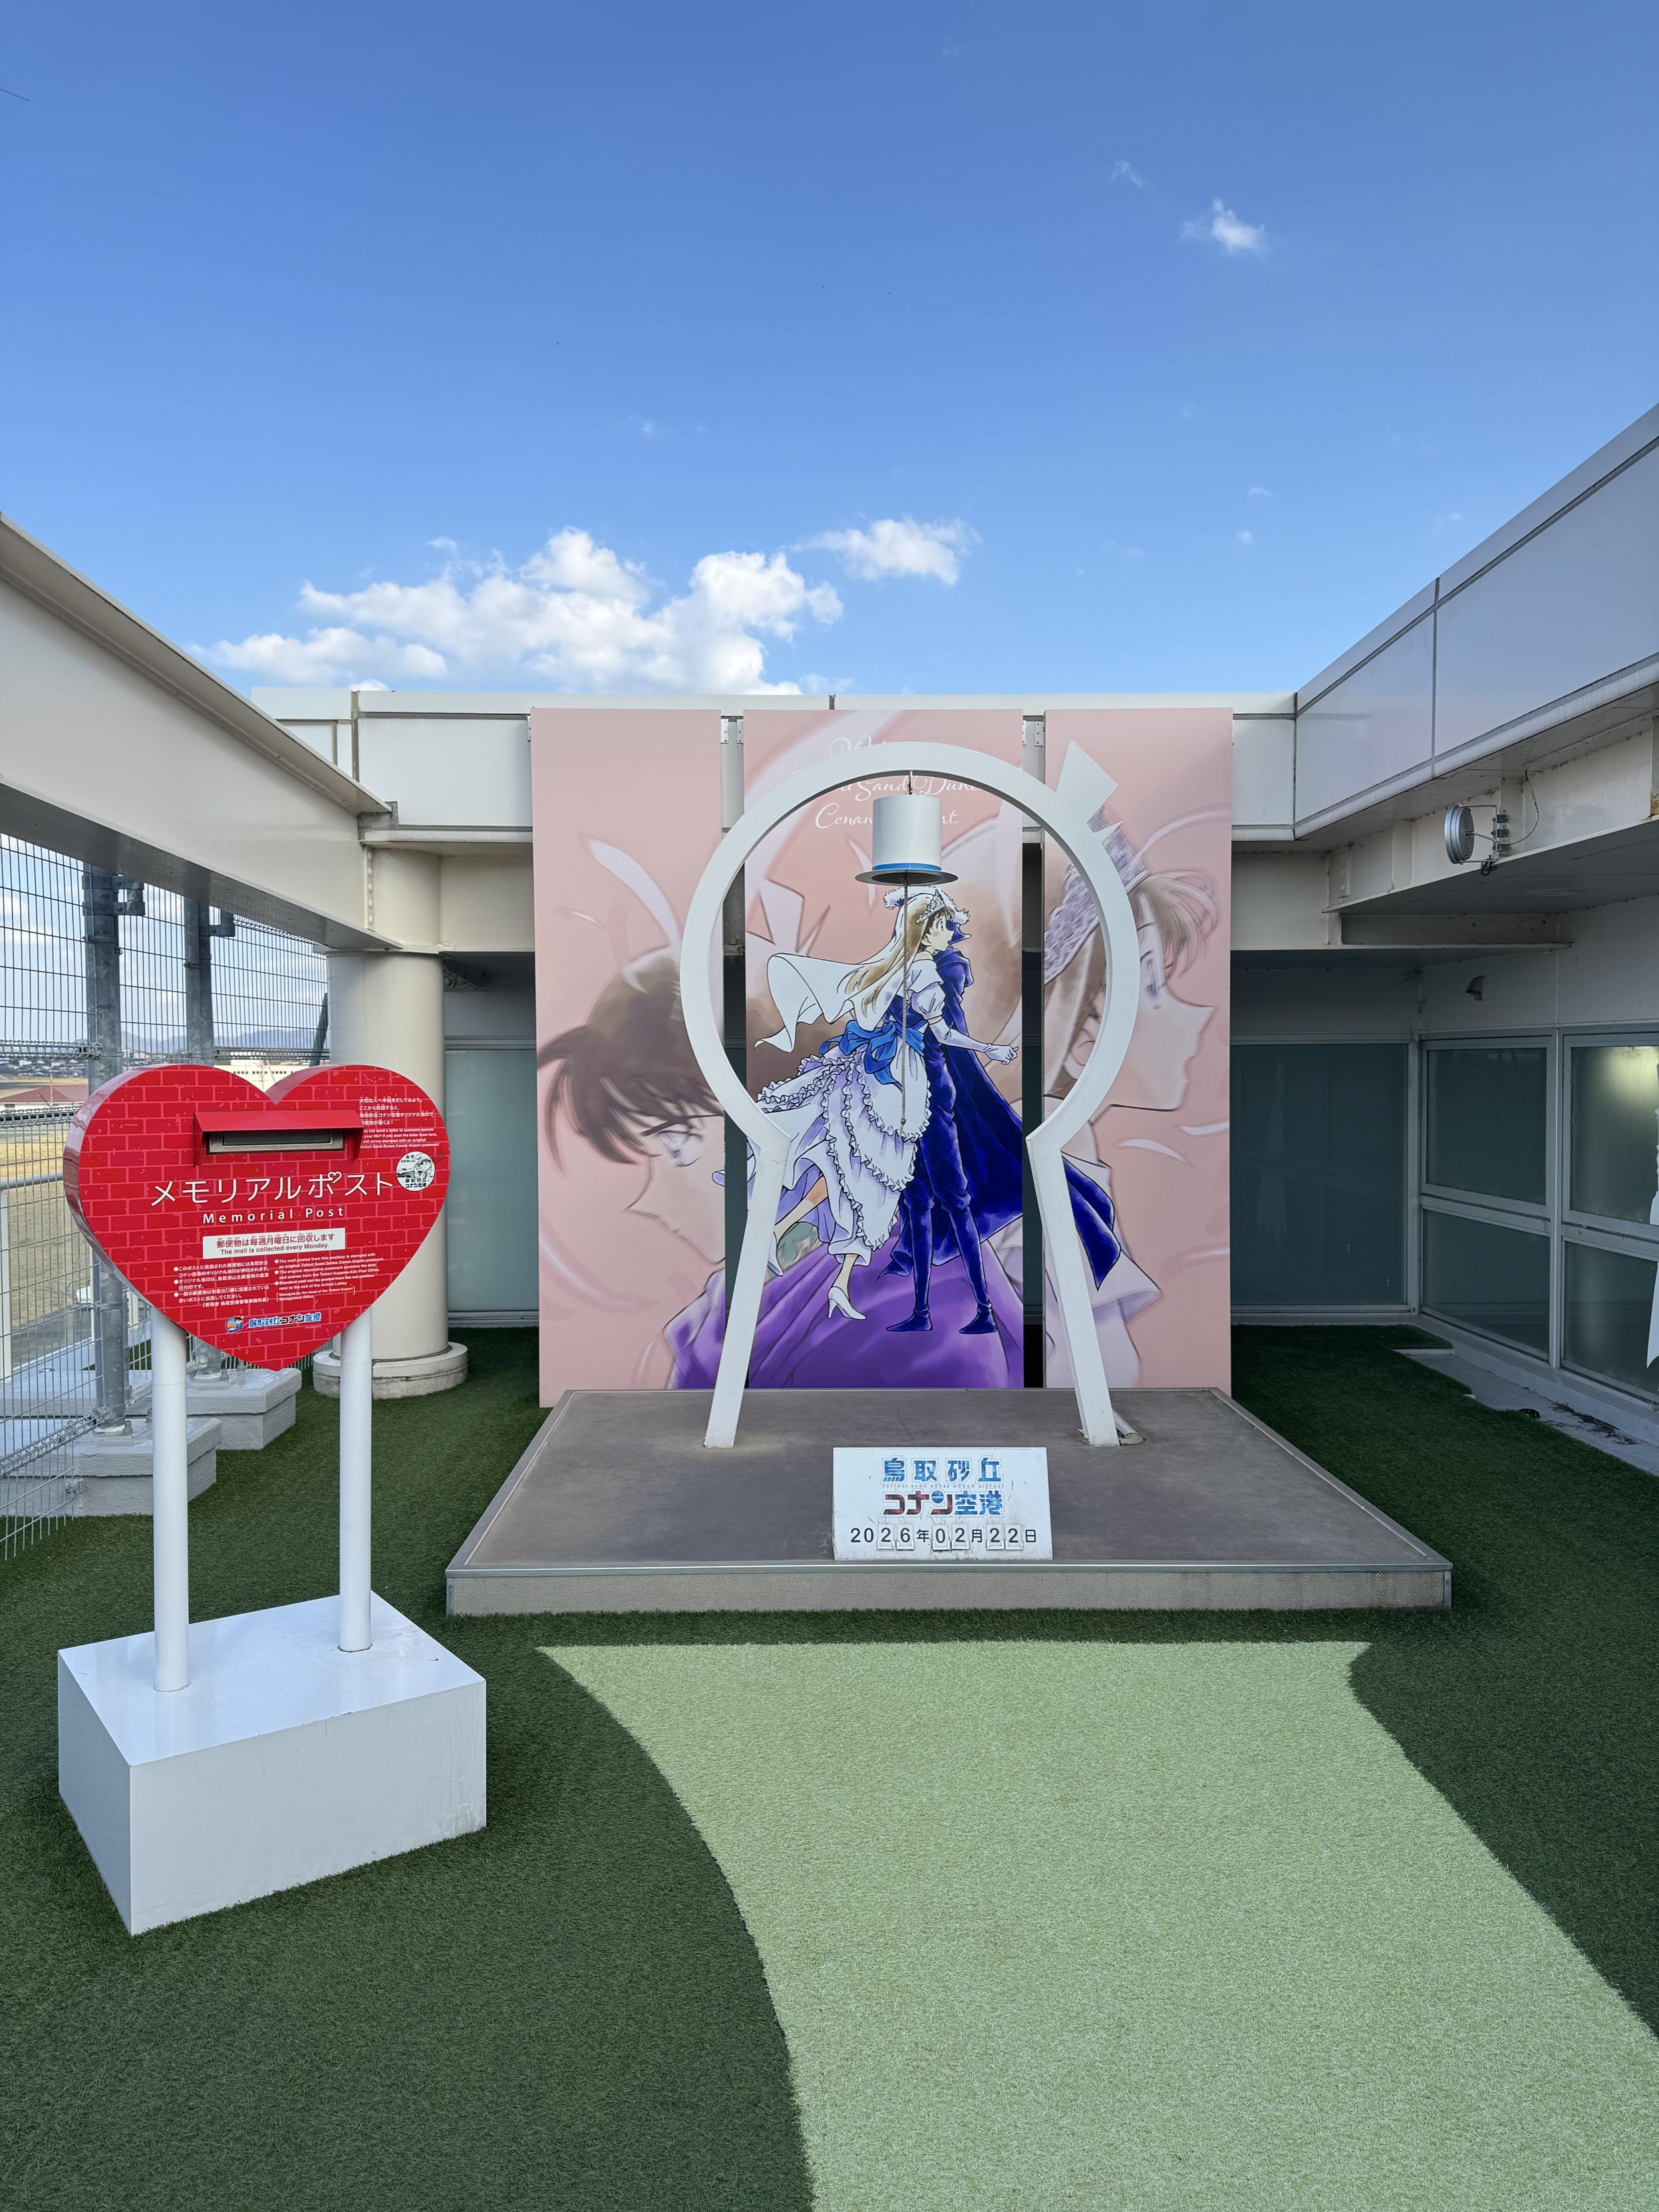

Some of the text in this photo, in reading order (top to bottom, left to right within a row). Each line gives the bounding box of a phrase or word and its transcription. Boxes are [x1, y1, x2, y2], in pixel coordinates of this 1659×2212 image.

[815, 802, 873, 828] Conan
[151, 1172, 393, 1206] メモリアルポスト
[203, 1207, 343, 1223] Memorial Post
[217, 1233, 335, 1248] 郵便物は毎週月曜日に回収します
[249, 1313, 321, 1327] 鳥取砂丘コナン空港
[883, 1458, 1001, 1482] 鳥取砂丘
[883, 1490, 1003, 1515] コナン空港
[850, 1527, 1037, 1543] 2026年02月22日
